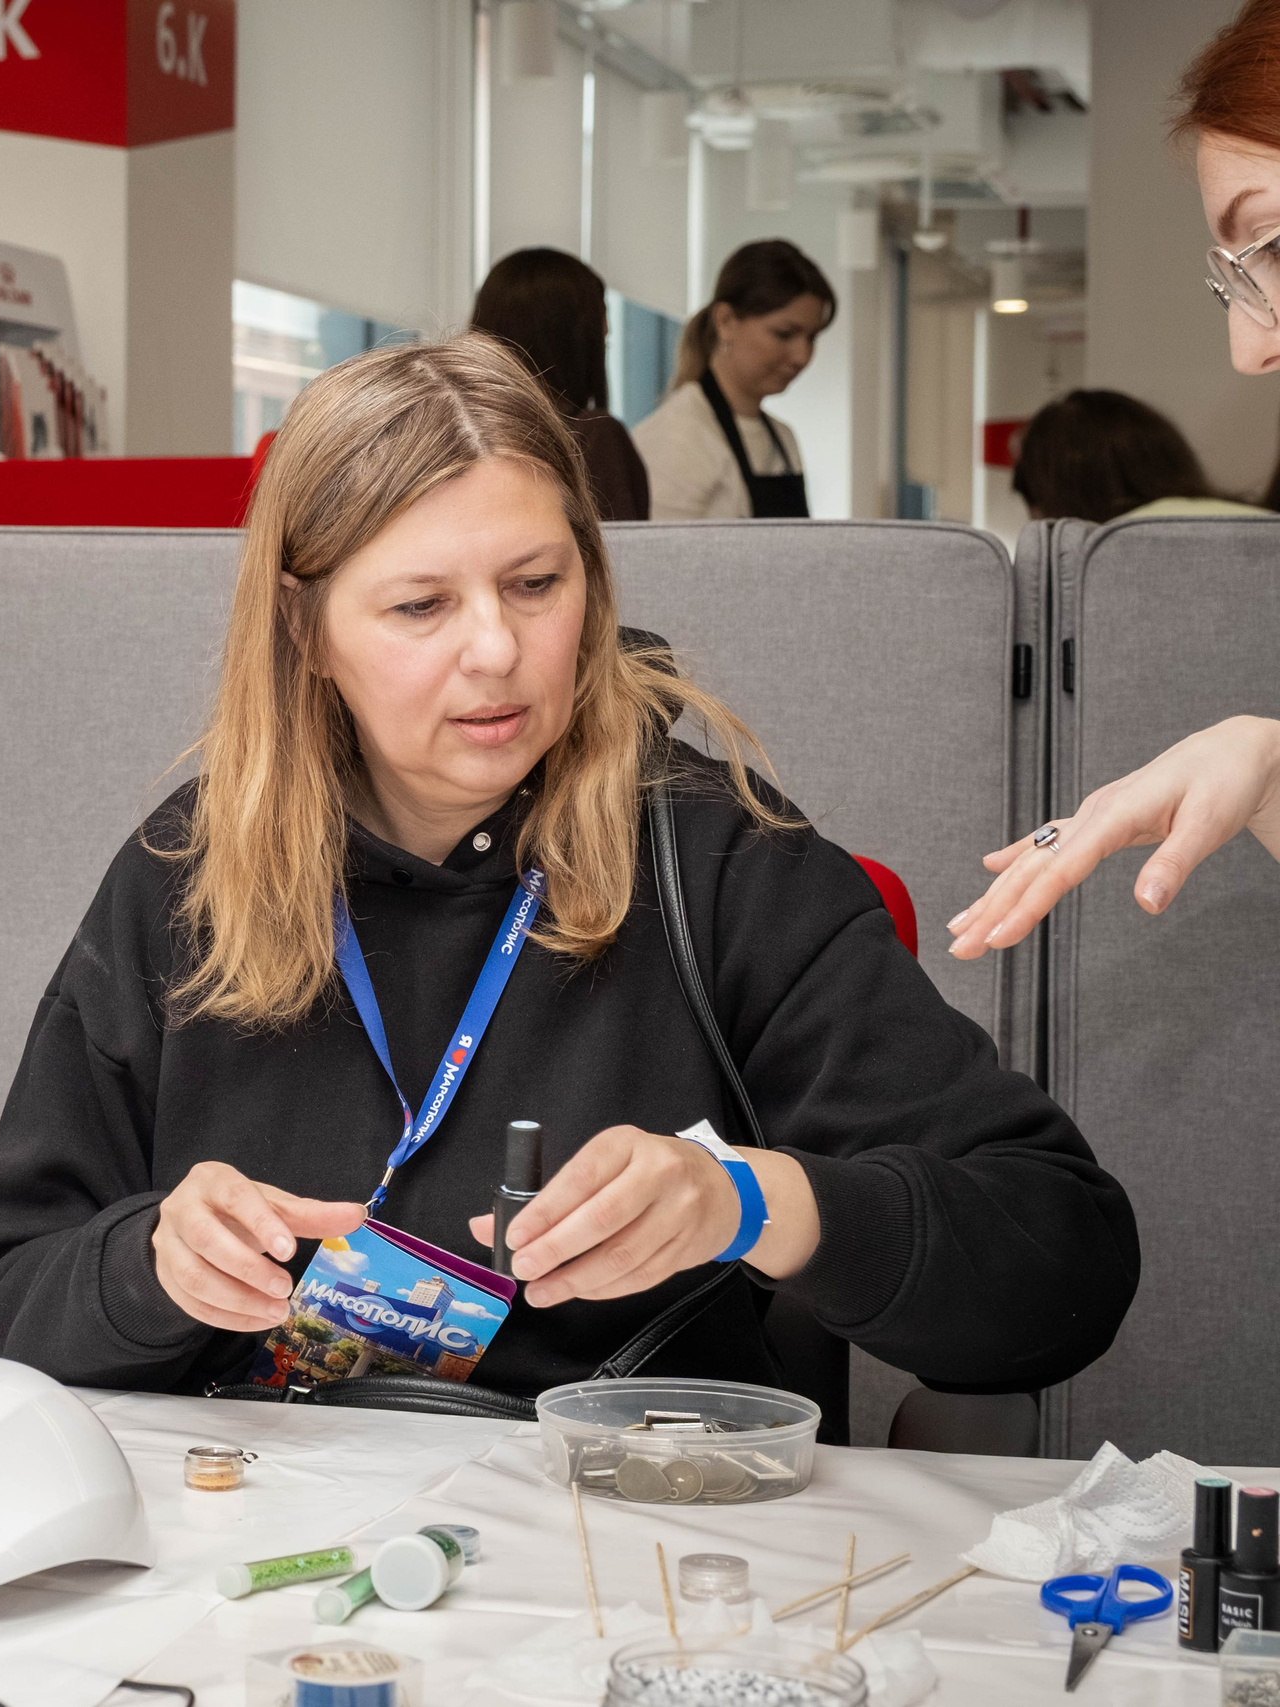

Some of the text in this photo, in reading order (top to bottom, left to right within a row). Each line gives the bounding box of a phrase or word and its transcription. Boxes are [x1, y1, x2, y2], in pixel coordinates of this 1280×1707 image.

[410, 1034, 473, 1143] Я МАРСОПОЛИС
[302, 1278, 472, 1349] МАРСОПОЛИС
[1221, 1603, 1253, 1619] BASIC
